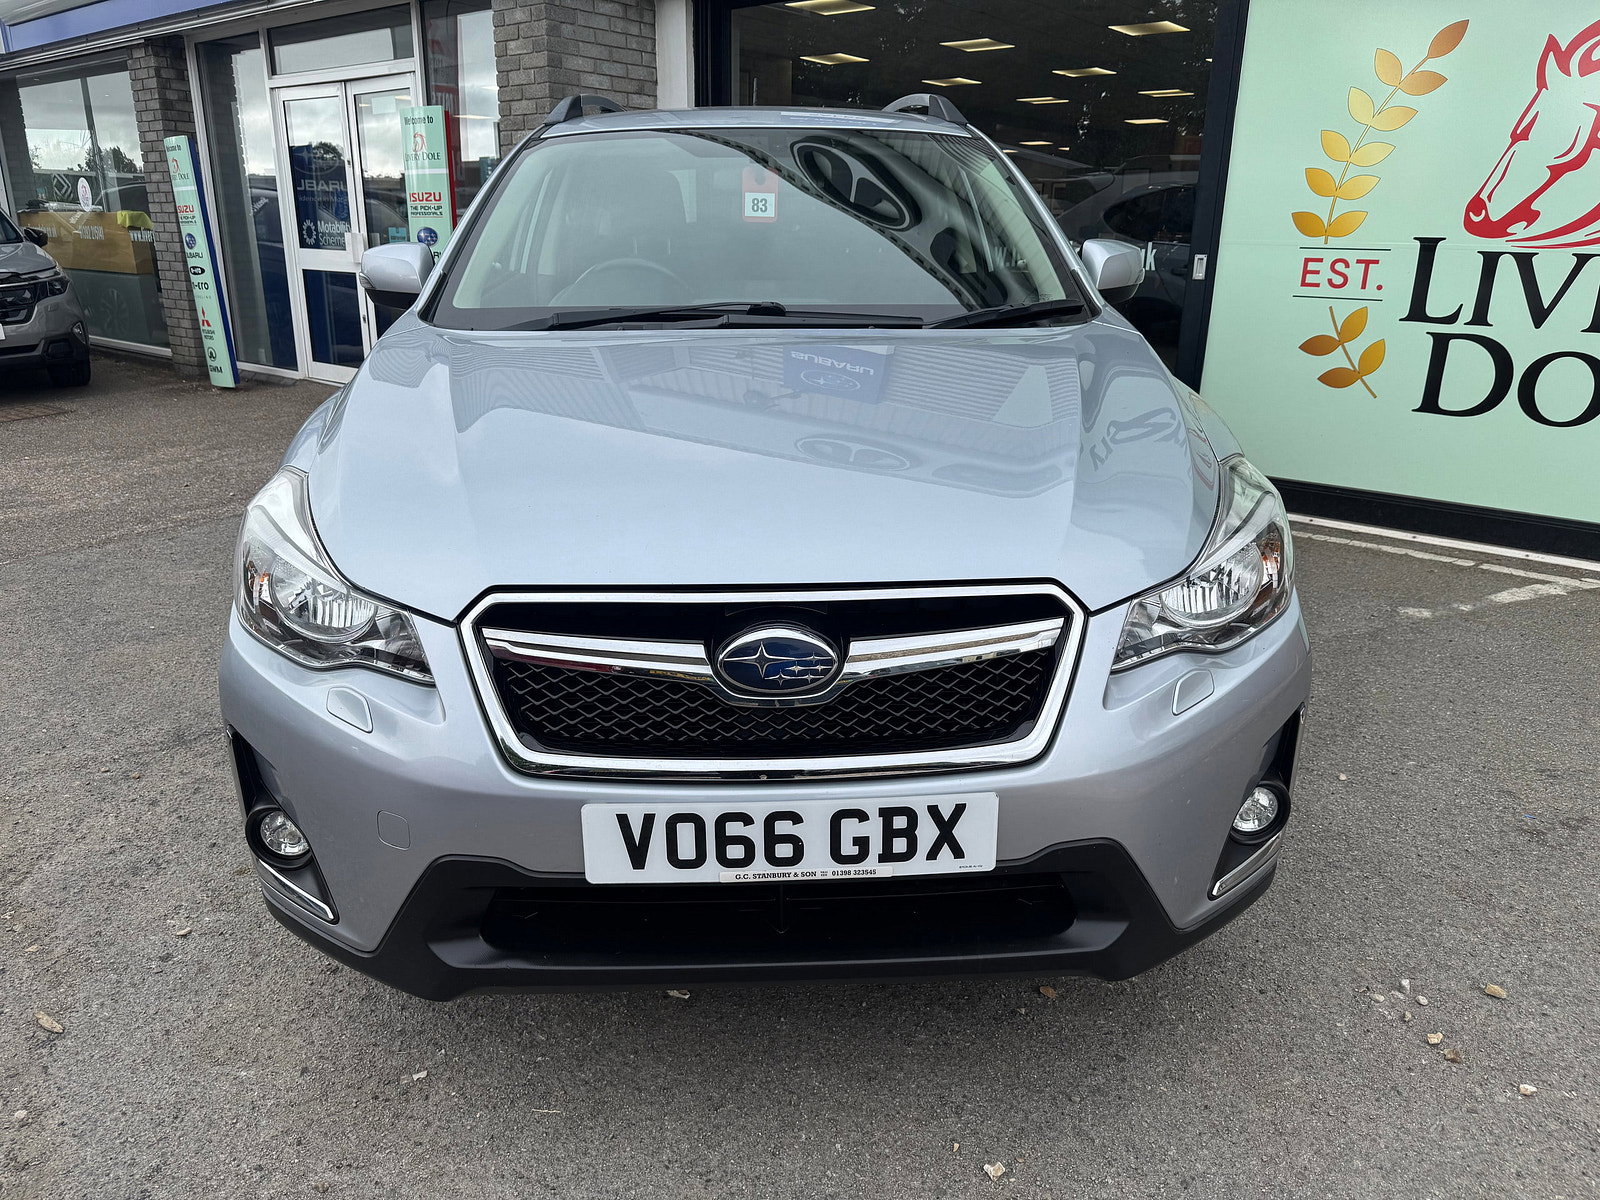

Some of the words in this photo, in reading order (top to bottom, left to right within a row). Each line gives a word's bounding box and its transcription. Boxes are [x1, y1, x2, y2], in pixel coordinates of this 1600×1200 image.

[427, 115, 434, 124] to
[422, 151, 441, 161] DOLE
[409, 192, 442, 203] ISUZU
[751, 197, 768, 213] 83
[1299, 257, 1384, 292] EST.
[1399, 236, 1600, 333] LIV
[615, 810, 805, 871] VO66
[829, 802, 968, 866] GBX
[752, 872, 792, 880] STANBURY
